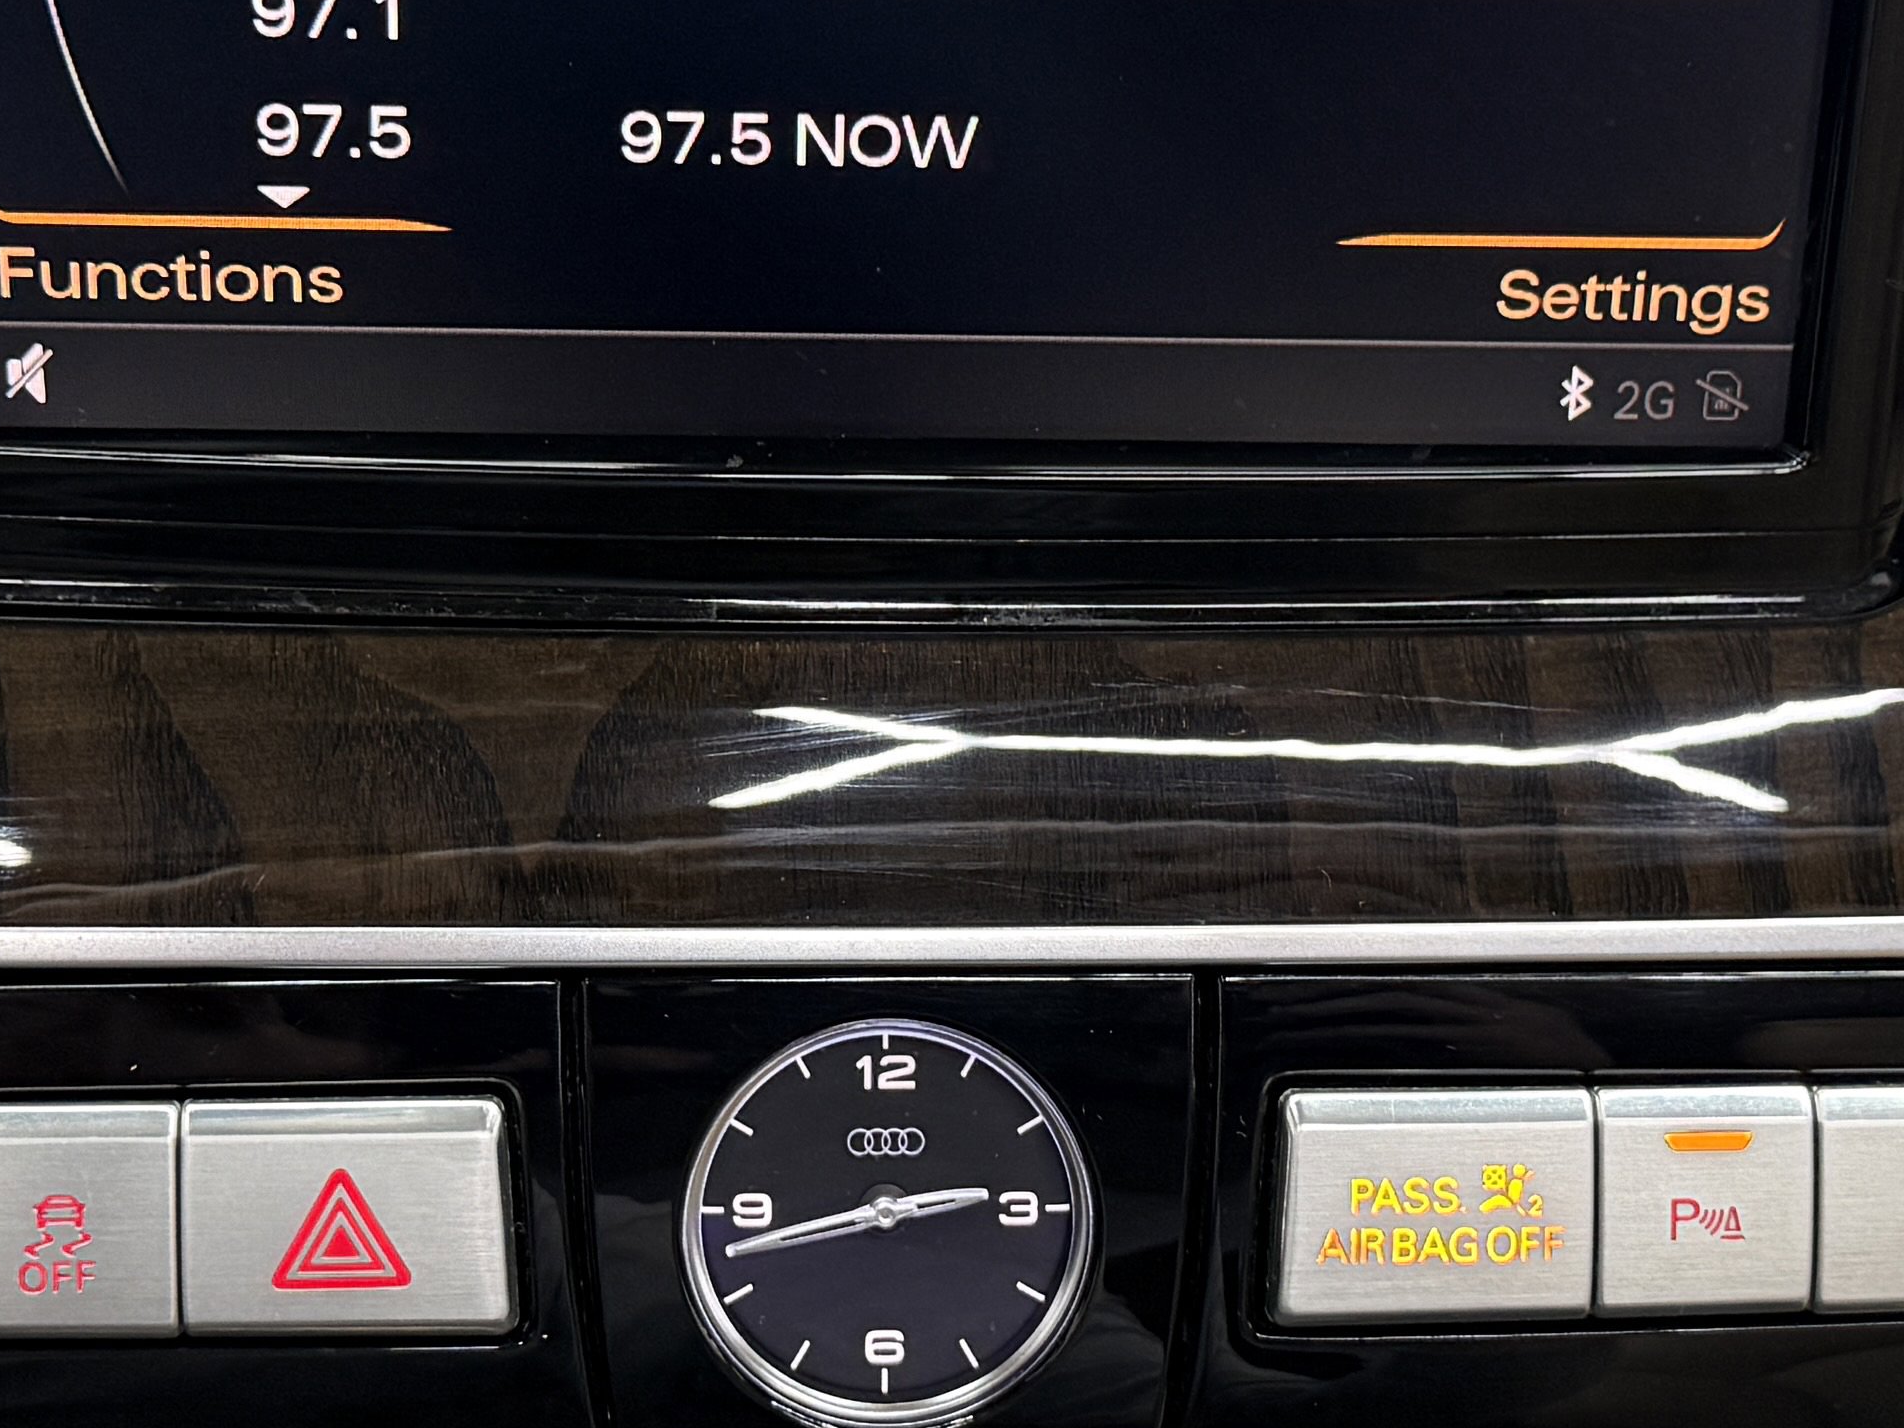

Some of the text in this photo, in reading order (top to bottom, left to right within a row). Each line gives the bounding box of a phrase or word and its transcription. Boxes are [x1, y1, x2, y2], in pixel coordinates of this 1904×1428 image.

[255, 102, 979, 171] 97.5 97.5 NOW
[1496, 268, 1770, 335] Settings
[1613, 380, 1676, 420] 2G
[855, 1054, 916, 1091] 12
[732, 1192, 773, 1229] 9
[998, 1190, 1039, 1227] 3
[1486, 1225, 1566, 1266] OFF
[17, 1259, 97, 1296] OFF
[864, 1329, 905, 1366] 6
